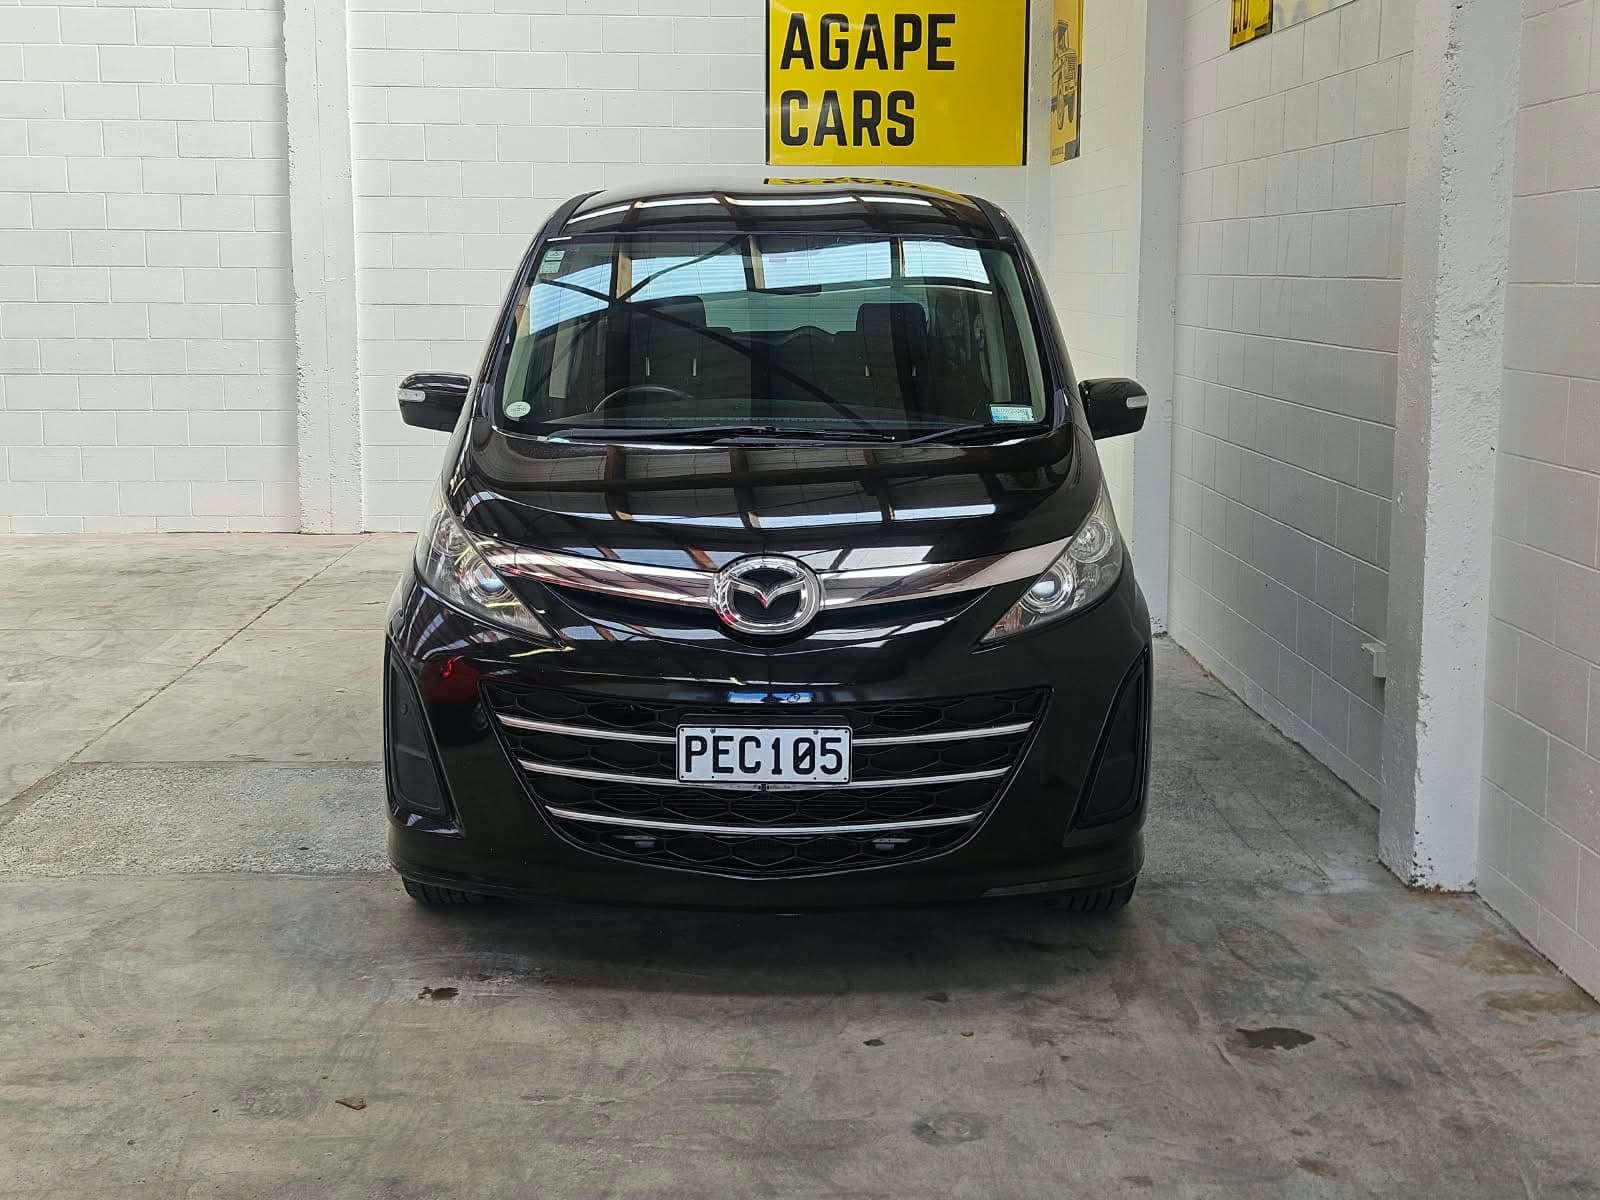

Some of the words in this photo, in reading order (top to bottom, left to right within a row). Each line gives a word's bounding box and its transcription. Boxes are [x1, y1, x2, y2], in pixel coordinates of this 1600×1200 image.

[780, 13, 956, 71] AGAPE
[780, 89, 915, 147] CARS
[685, 735, 843, 776] PEC105
